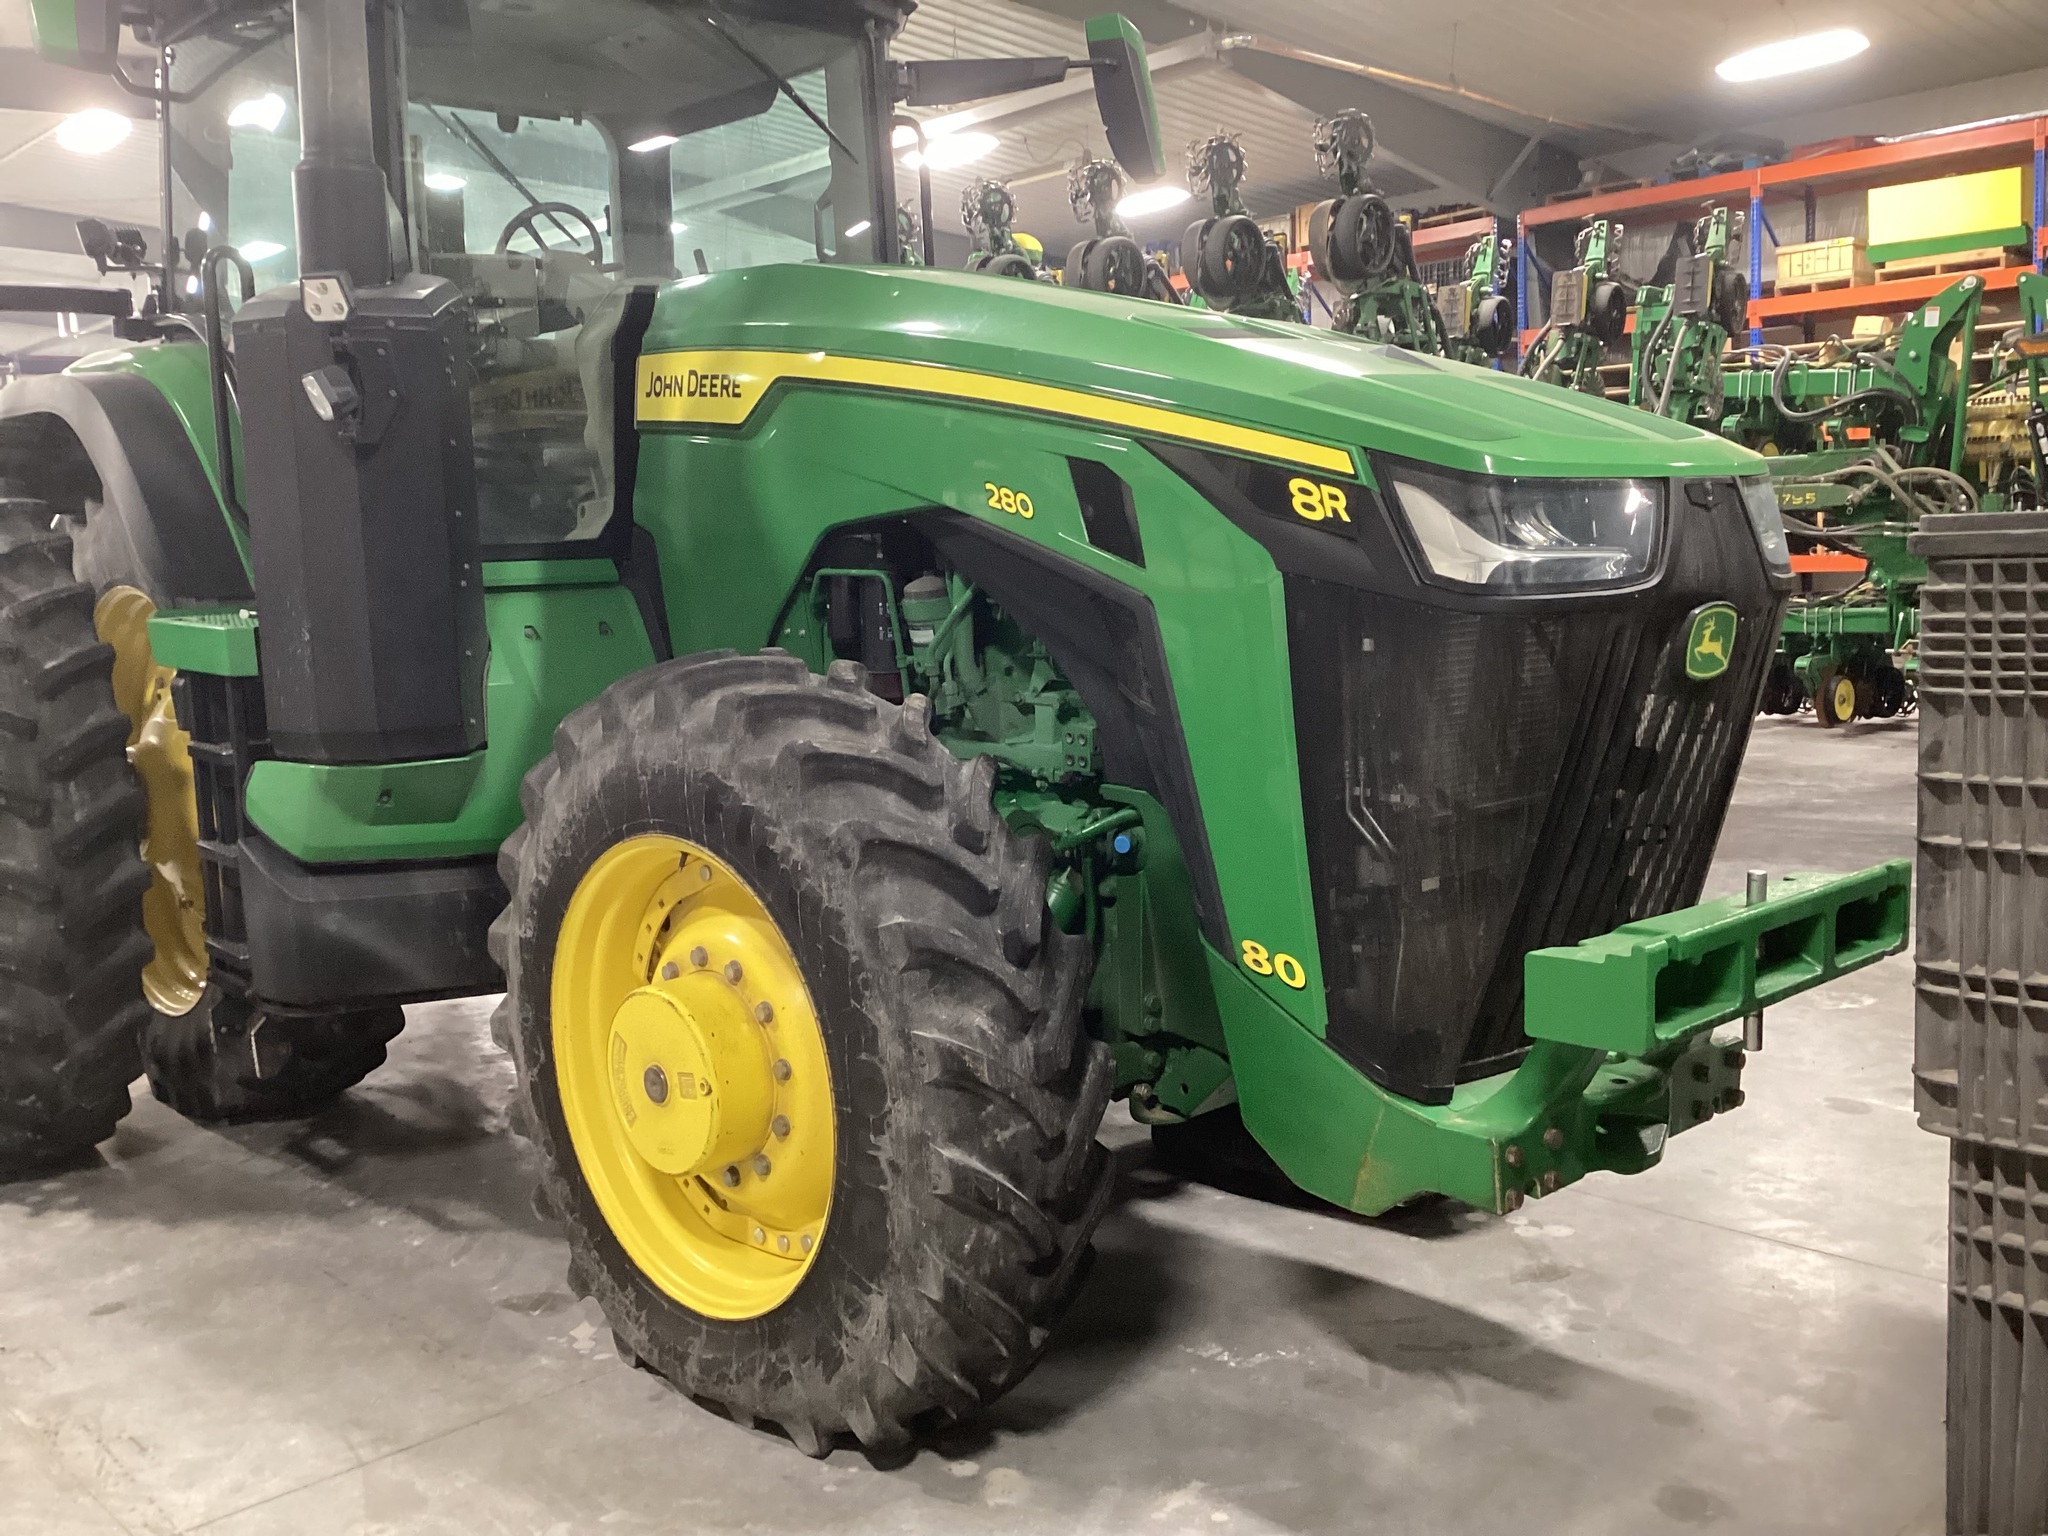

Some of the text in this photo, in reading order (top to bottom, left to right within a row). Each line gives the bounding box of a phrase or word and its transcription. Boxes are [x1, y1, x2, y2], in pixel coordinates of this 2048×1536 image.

[645, 369, 743, 399] JOHN DEERE
[984, 481, 1034, 519] 280
[1289, 477, 1351, 523] 8R
[1241, 939, 1307, 989] 80
